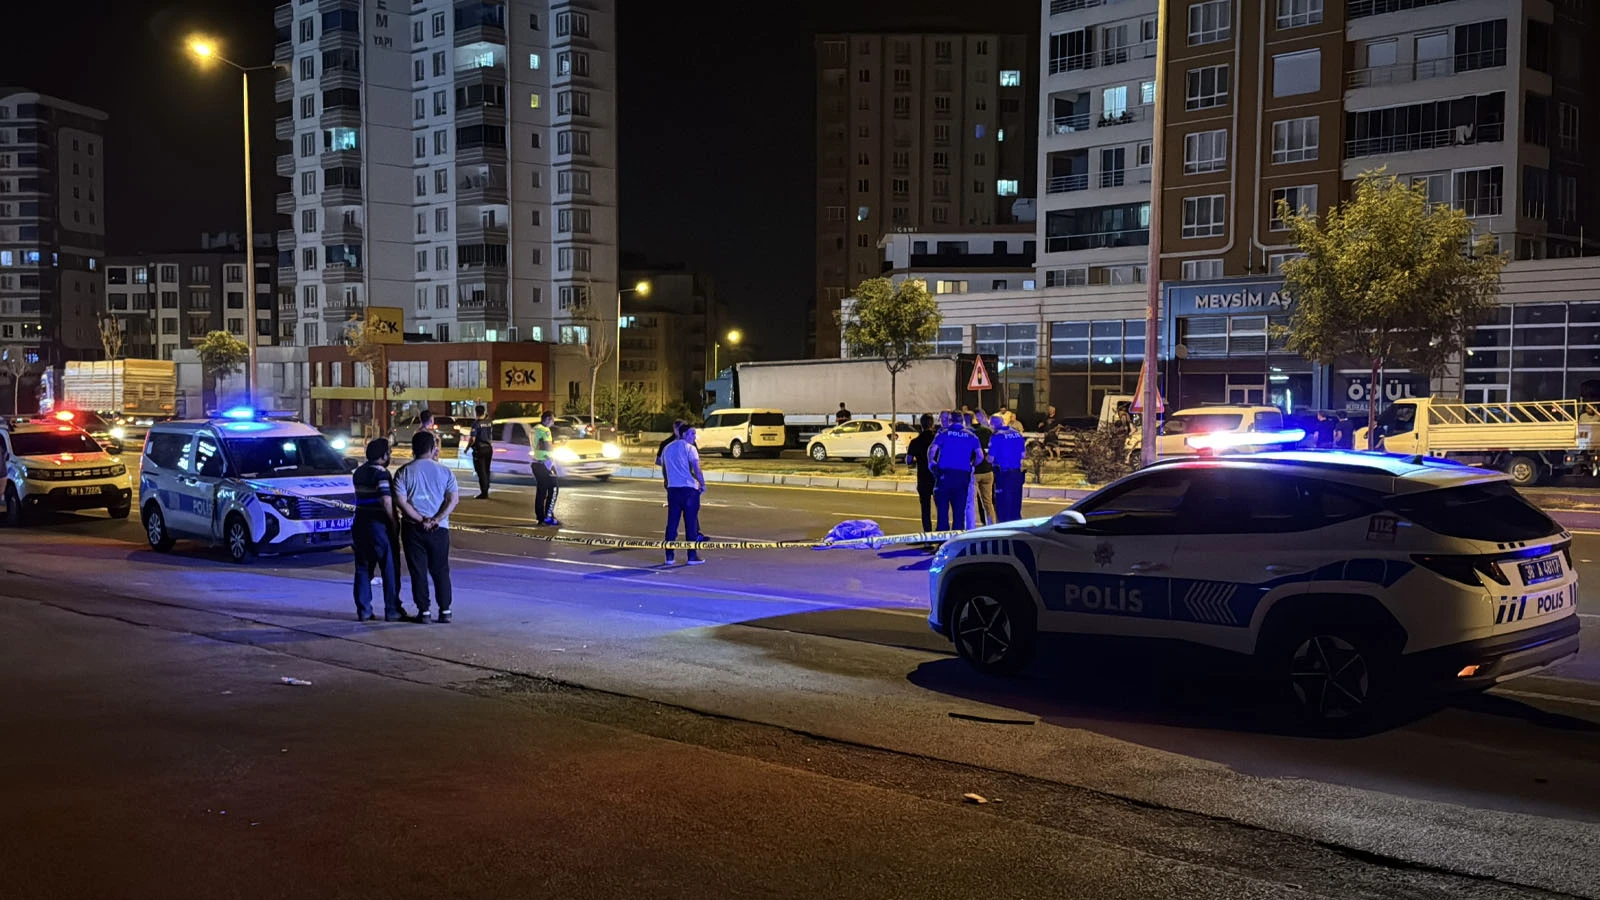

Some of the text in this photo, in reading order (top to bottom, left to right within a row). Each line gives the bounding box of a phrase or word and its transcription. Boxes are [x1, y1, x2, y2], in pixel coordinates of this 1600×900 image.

[372, 35, 393, 48] YAPI
[1195, 288, 1292, 310] MEVSİM AŞ
[505, 368, 536, 388] ŞOK
[1347, 379, 1417, 401] ÖDÜL
[1536, 562, 1544, 577] A
[1064, 580, 1143, 613] POLİS
